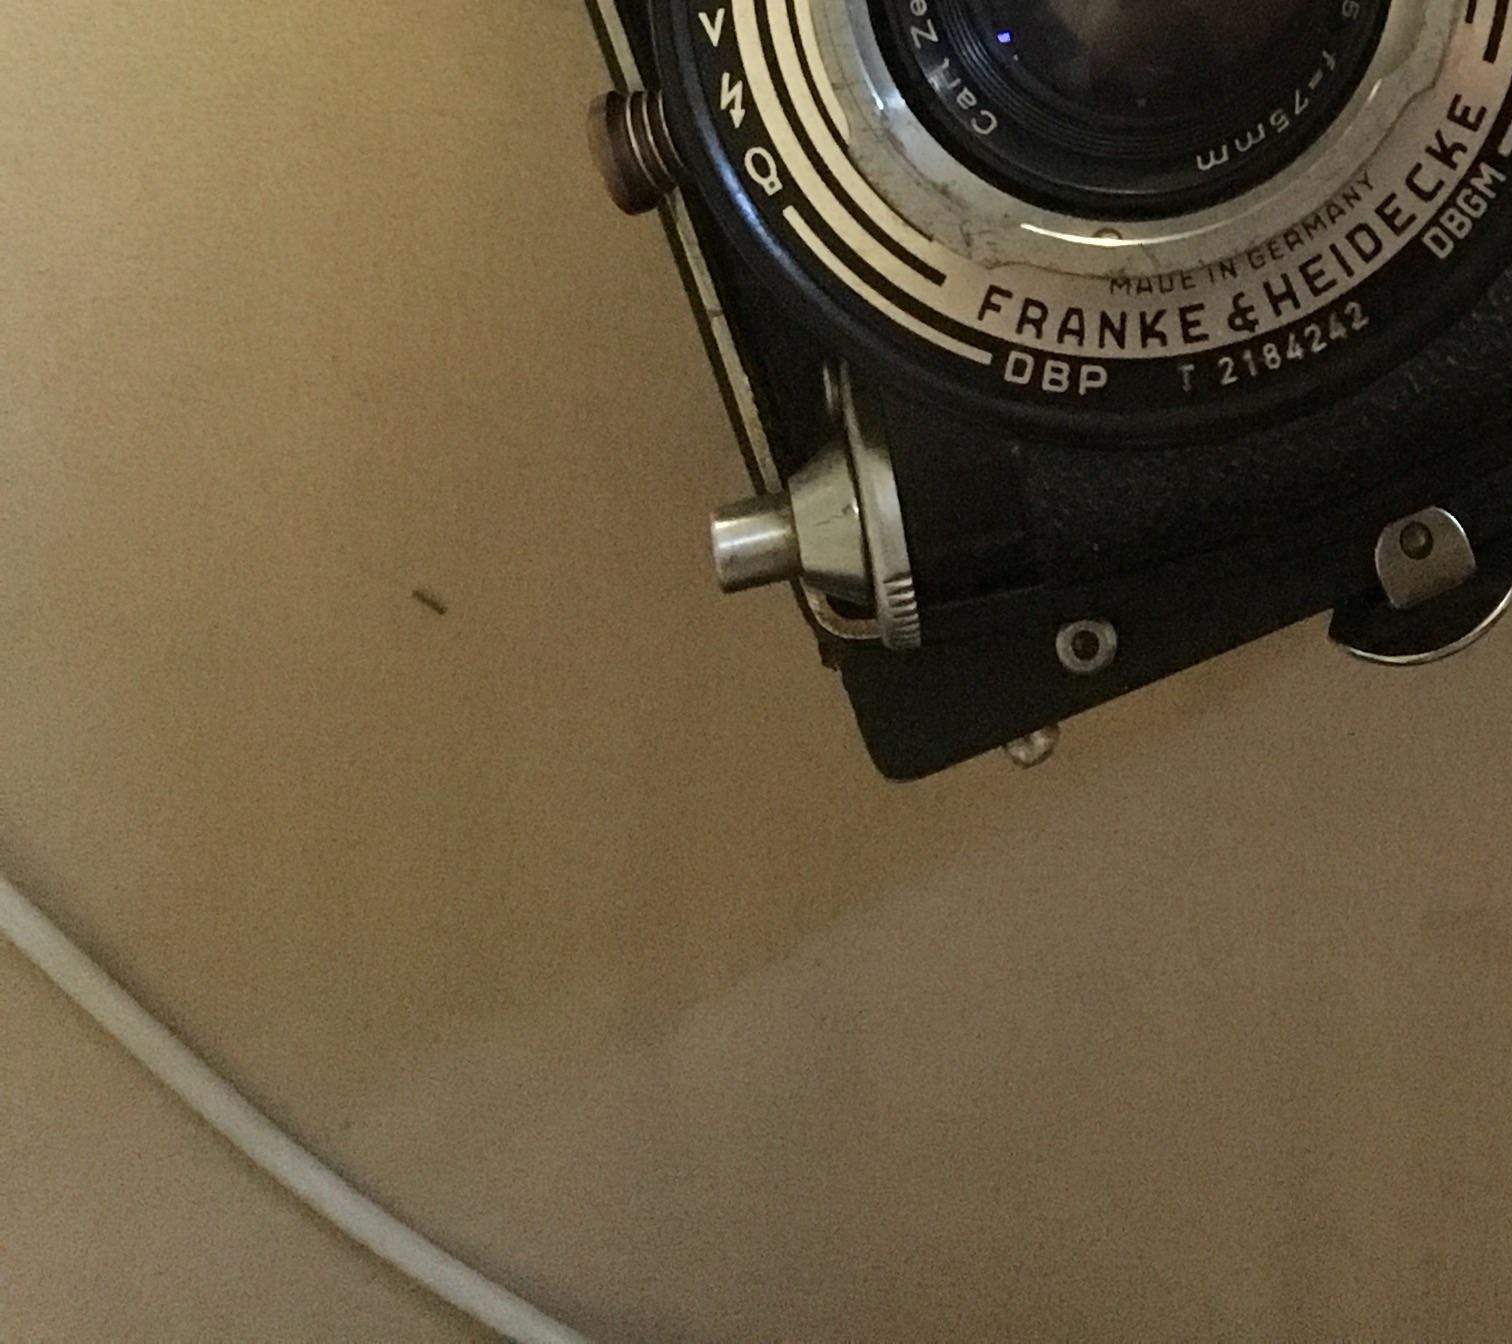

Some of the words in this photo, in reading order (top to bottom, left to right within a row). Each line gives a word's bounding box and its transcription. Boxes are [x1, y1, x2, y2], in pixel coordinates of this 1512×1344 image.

[976, 282, 1210, 351] FRANKE
[1226, 290, 1260, 334] &
[1262, 92, 1489, 318] HEIDECKE
[1002, 349, 1109, 397] DBP
[1217, 300, 1371, 387] 2184242
[1420, 160, 1507, 261] DBGM
[1108, 271, 1197, 296] MADE
[1207, 259, 1239, 284] IN
[1249, 167, 1376, 271] GERMANY
